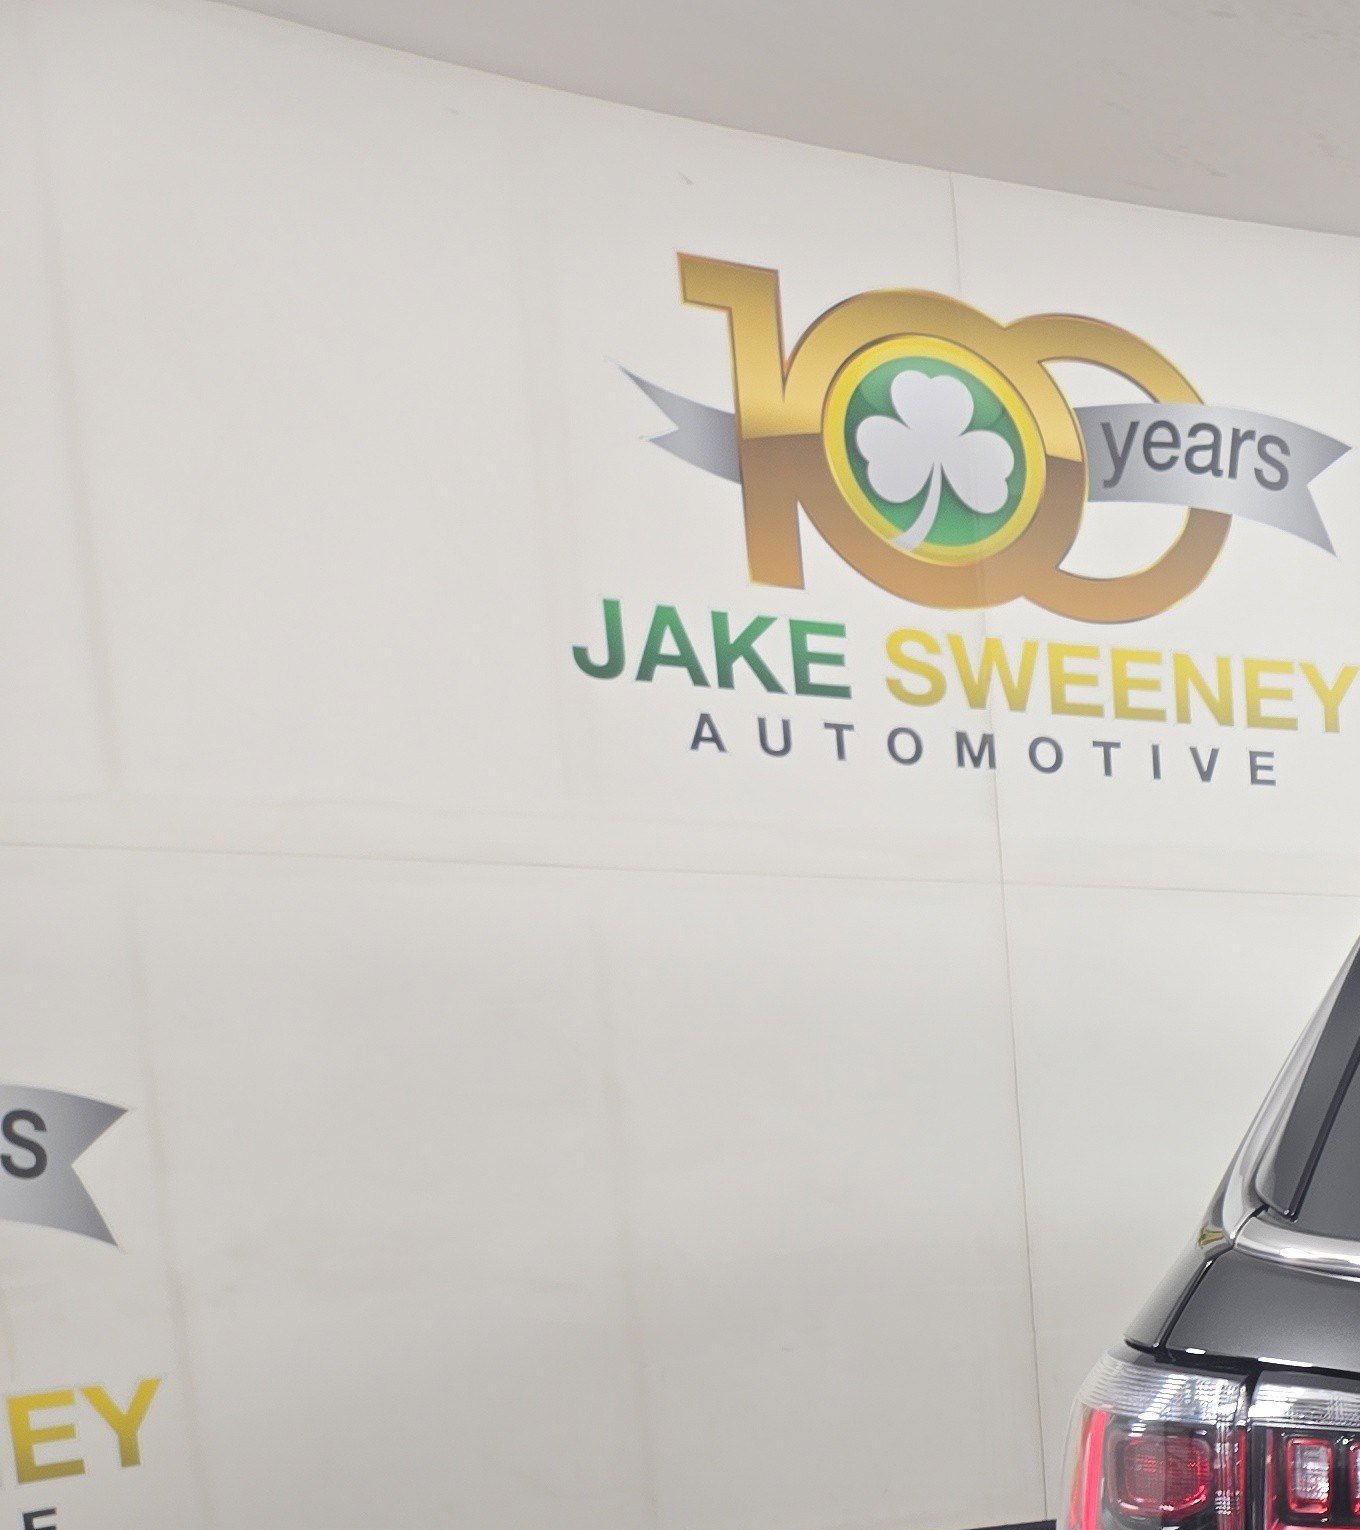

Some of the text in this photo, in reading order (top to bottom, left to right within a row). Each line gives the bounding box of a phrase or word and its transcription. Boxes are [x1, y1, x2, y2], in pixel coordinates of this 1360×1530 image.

[1100, 418, 1292, 492] years
[572, 598, 853, 701] JAKE
[689, 712, 1278, 787] AUTOMOTIVE
